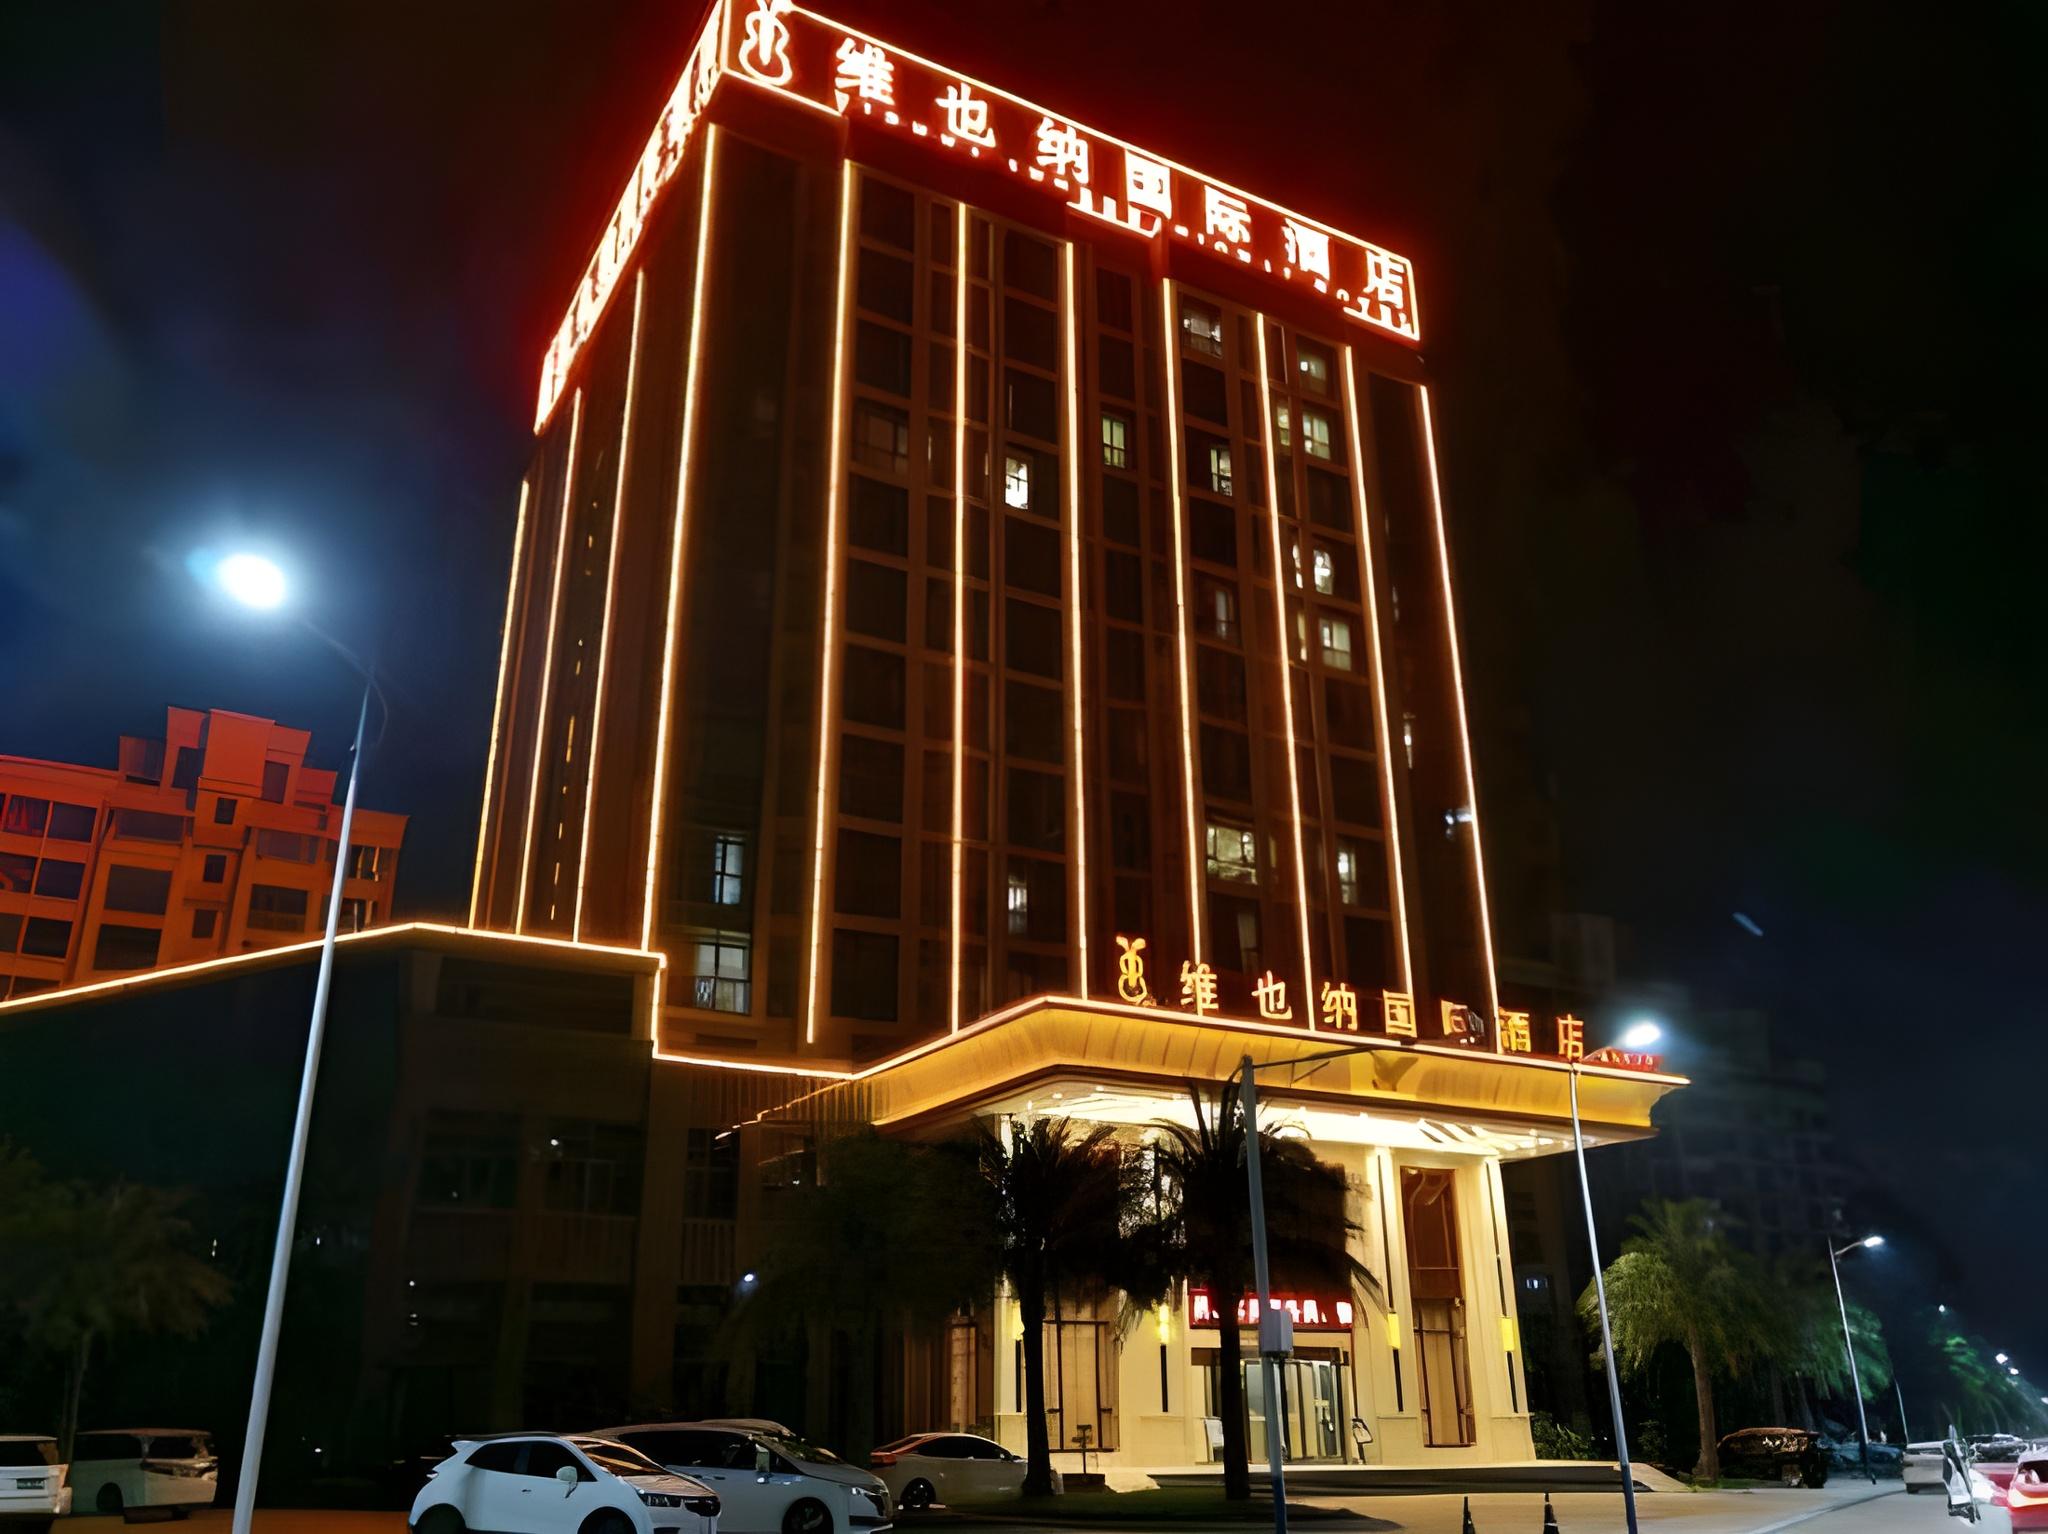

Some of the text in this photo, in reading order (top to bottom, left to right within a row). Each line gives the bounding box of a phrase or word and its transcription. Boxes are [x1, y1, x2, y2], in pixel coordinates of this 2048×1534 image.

[835, 37, 1404, 309] 维也纳国际酒店
